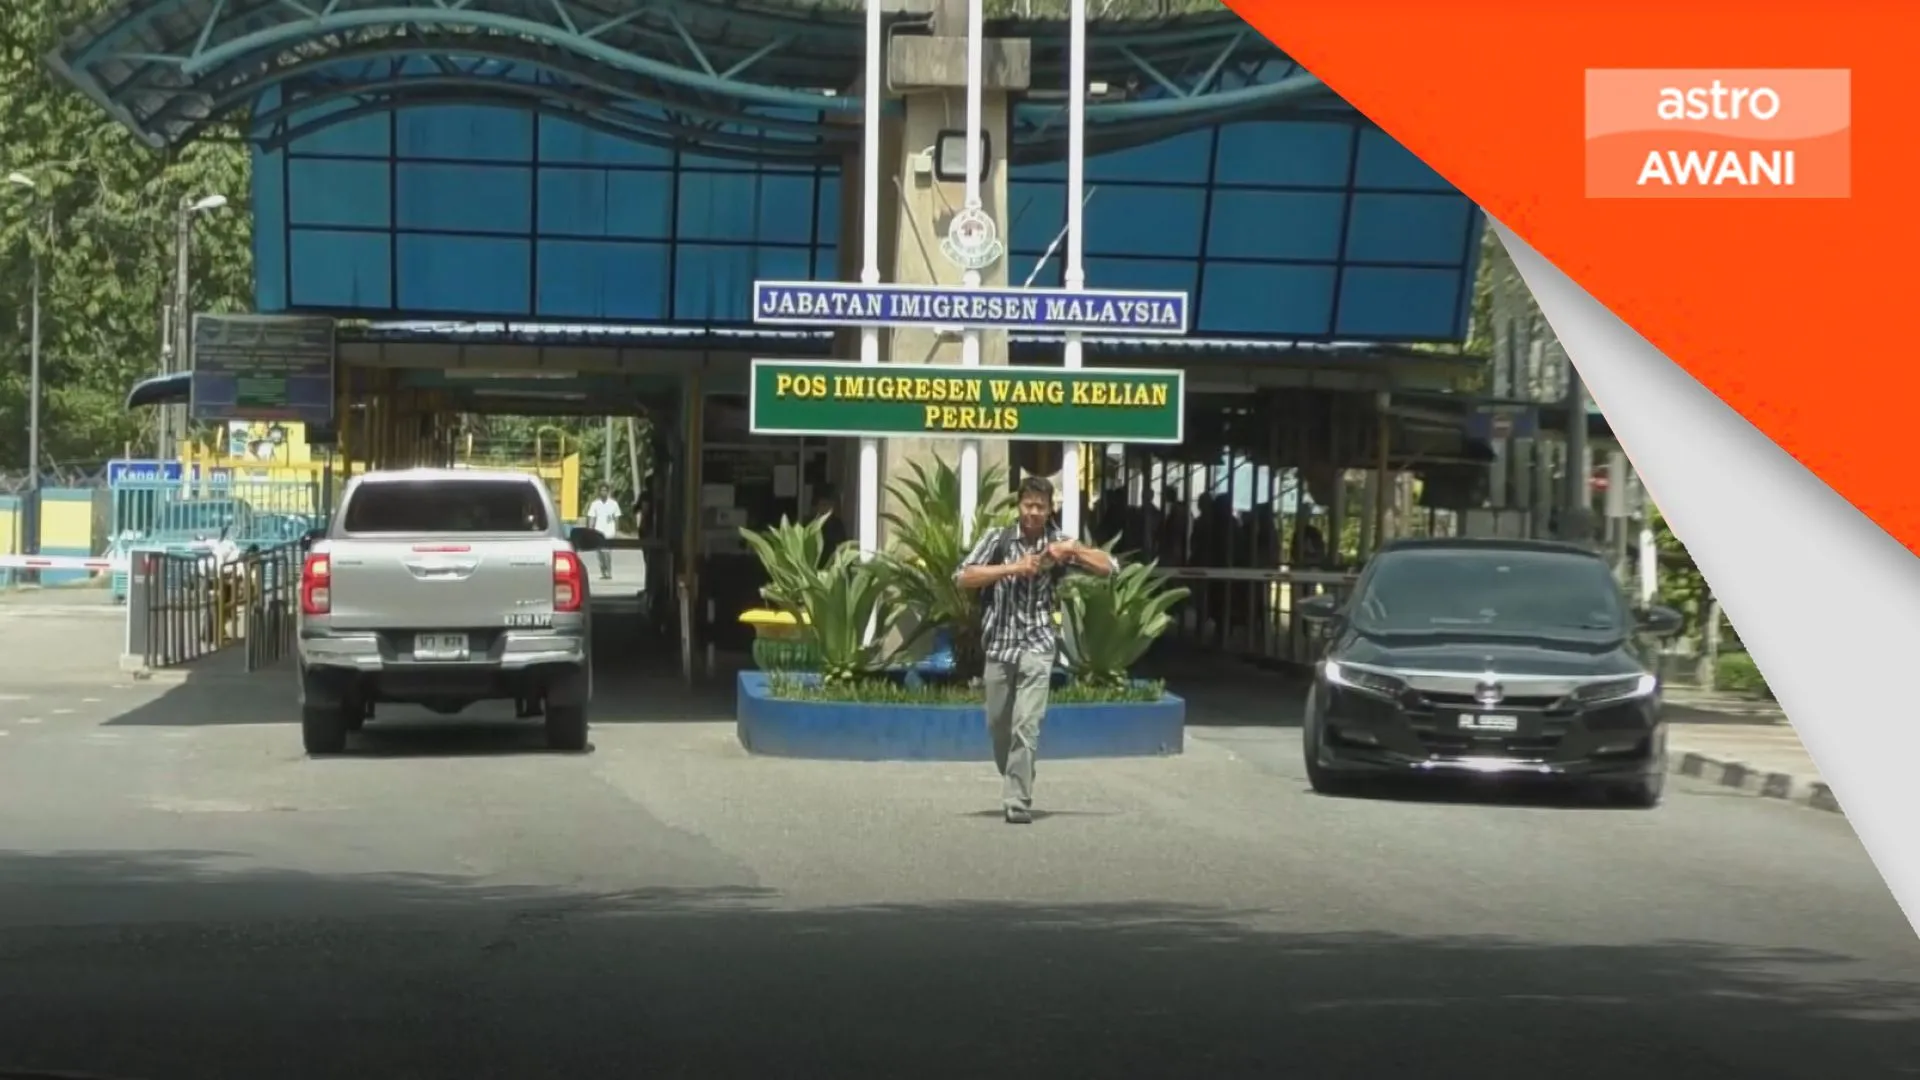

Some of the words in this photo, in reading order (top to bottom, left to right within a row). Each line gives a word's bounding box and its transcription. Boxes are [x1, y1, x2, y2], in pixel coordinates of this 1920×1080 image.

[763, 291, 883, 317] JABATAN
[890, 294, 1037, 321] IMIGRESEN
[1045, 299, 1178, 324] MALAYSIA
[776, 373, 827, 397] POS
[833, 376, 982, 401] IMIGRESEN
[989, 380, 1065, 404] WANG
[1071, 381, 1168, 406] KELIAN
[925, 405, 1019, 430] PERLIS
